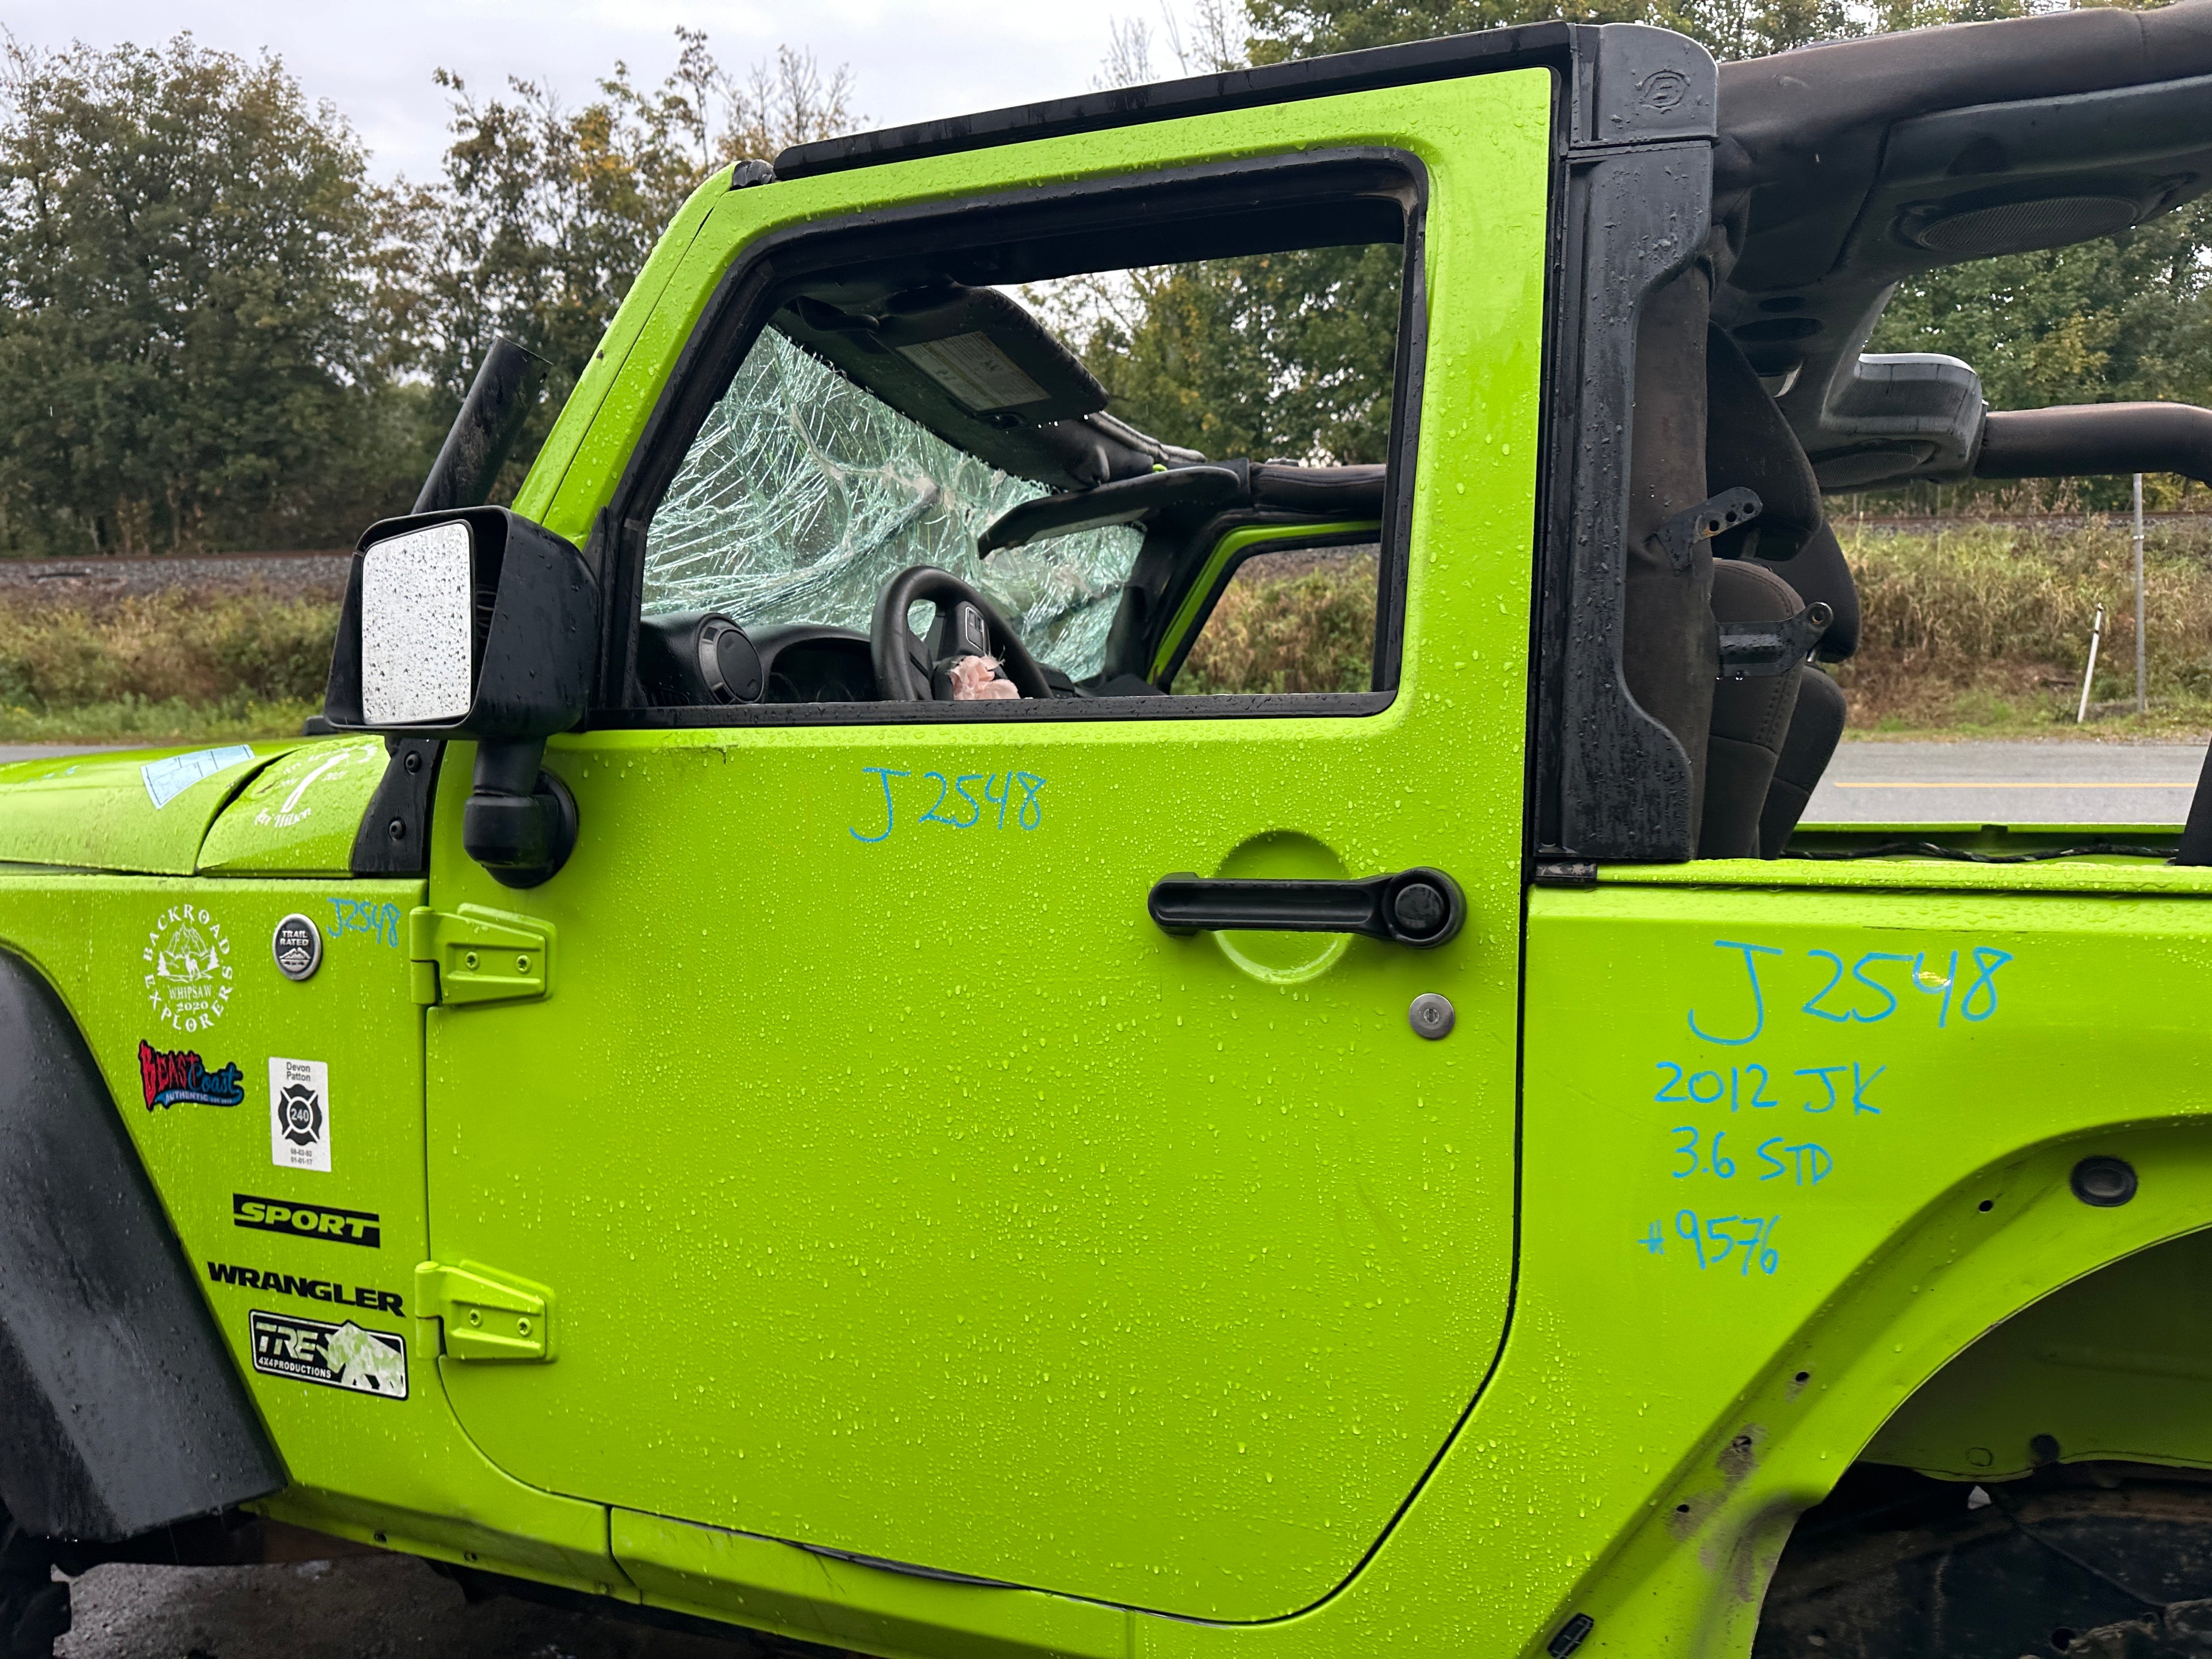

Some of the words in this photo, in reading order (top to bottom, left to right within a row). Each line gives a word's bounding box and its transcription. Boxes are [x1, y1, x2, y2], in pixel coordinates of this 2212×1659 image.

[849, 767, 911, 843] J
[918, 770, 1046, 831] 2548
[143, 904, 230, 961] BACKROAD
[282, 930, 308, 938] TRAIL
[280, 938, 309, 946] RATED
[168, 984, 212, 1001] WHIPSAW
[1688, 940, 1783, 1046] J
[1801, 946, 2014, 1028] 2548
[177, 1001, 209, 1012] 2020
[286, 1062, 310, 1073] Devon
[286, 1071, 311, 1082] Patton
[165, 1090, 209, 1104] AUTHENTIC
[1654, 1061, 1779, 1113] 2012
[1794, 1061, 1887, 1116] JK
[291, 1108, 309, 1122] 240
[1671, 1126, 1736, 1179] 3.6
[1756, 1137, 1833, 1185] STD
[234, 1202, 380, 1238] SPORT
[207, 1261, 406, 1317] WRANGLER
